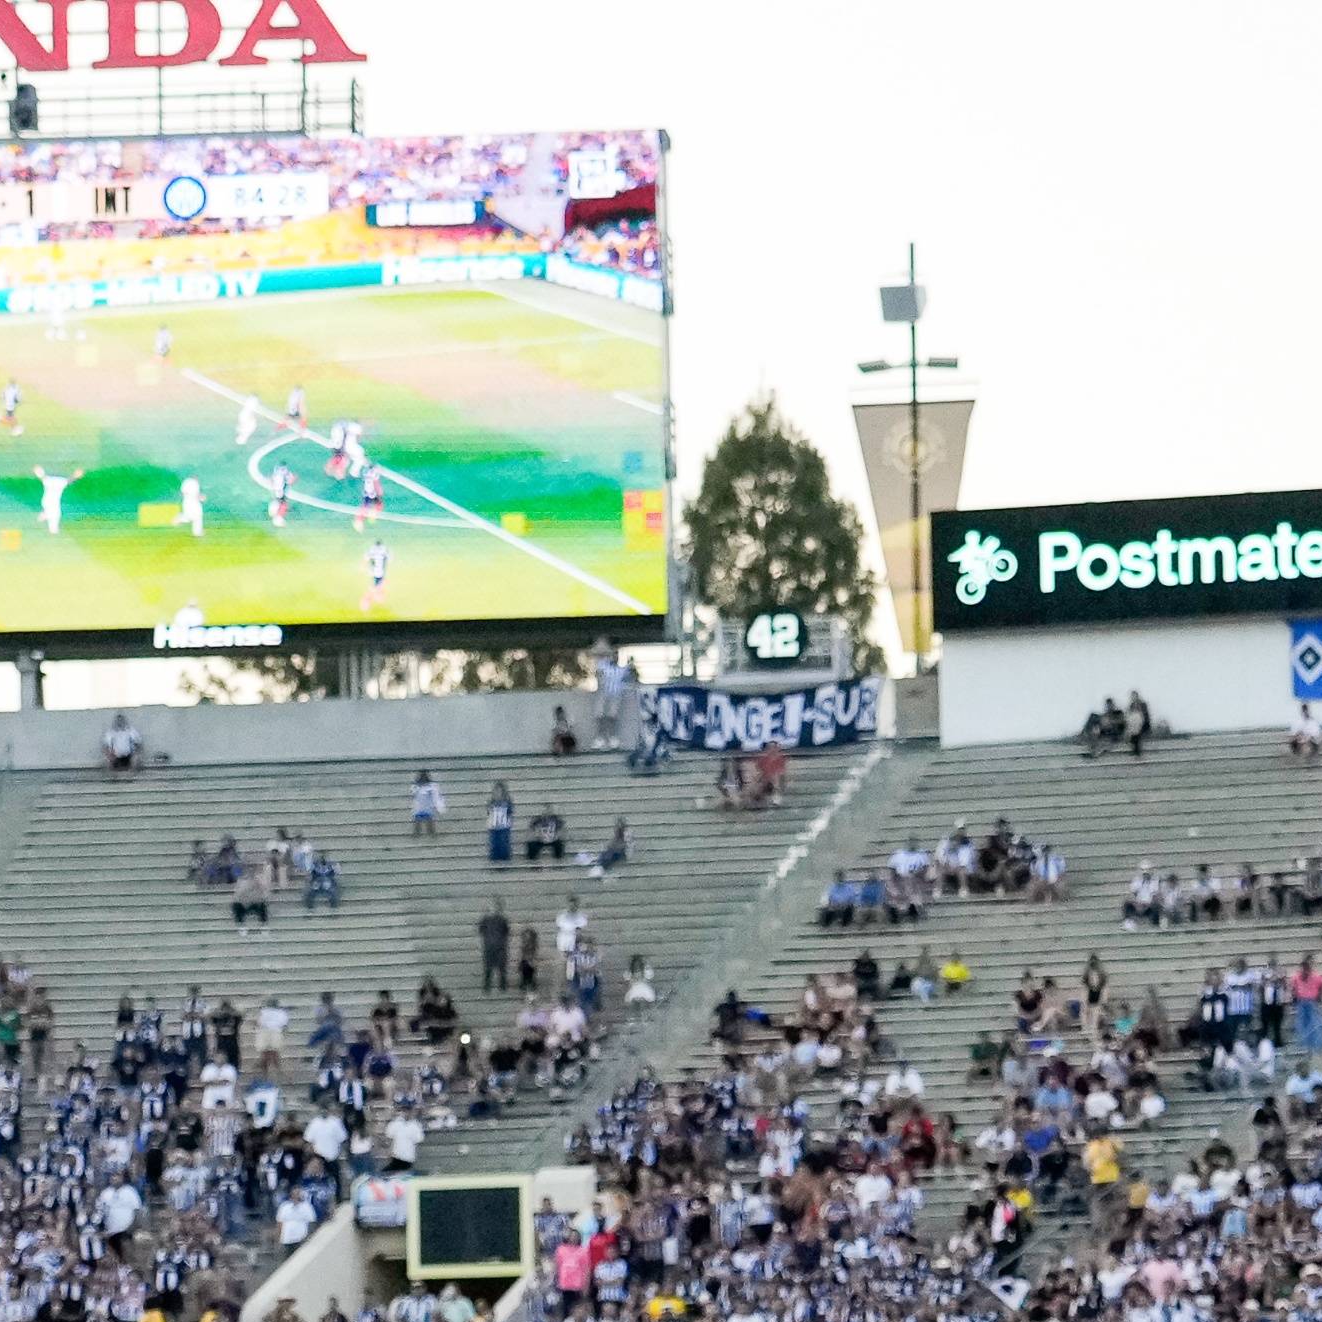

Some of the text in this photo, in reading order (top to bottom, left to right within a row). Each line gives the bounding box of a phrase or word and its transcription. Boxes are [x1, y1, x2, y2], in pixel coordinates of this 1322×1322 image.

[95, 187, 132, 215] INT
[153, 622, 283, 649] Hisense
[746, 612, 800, 659] 42
